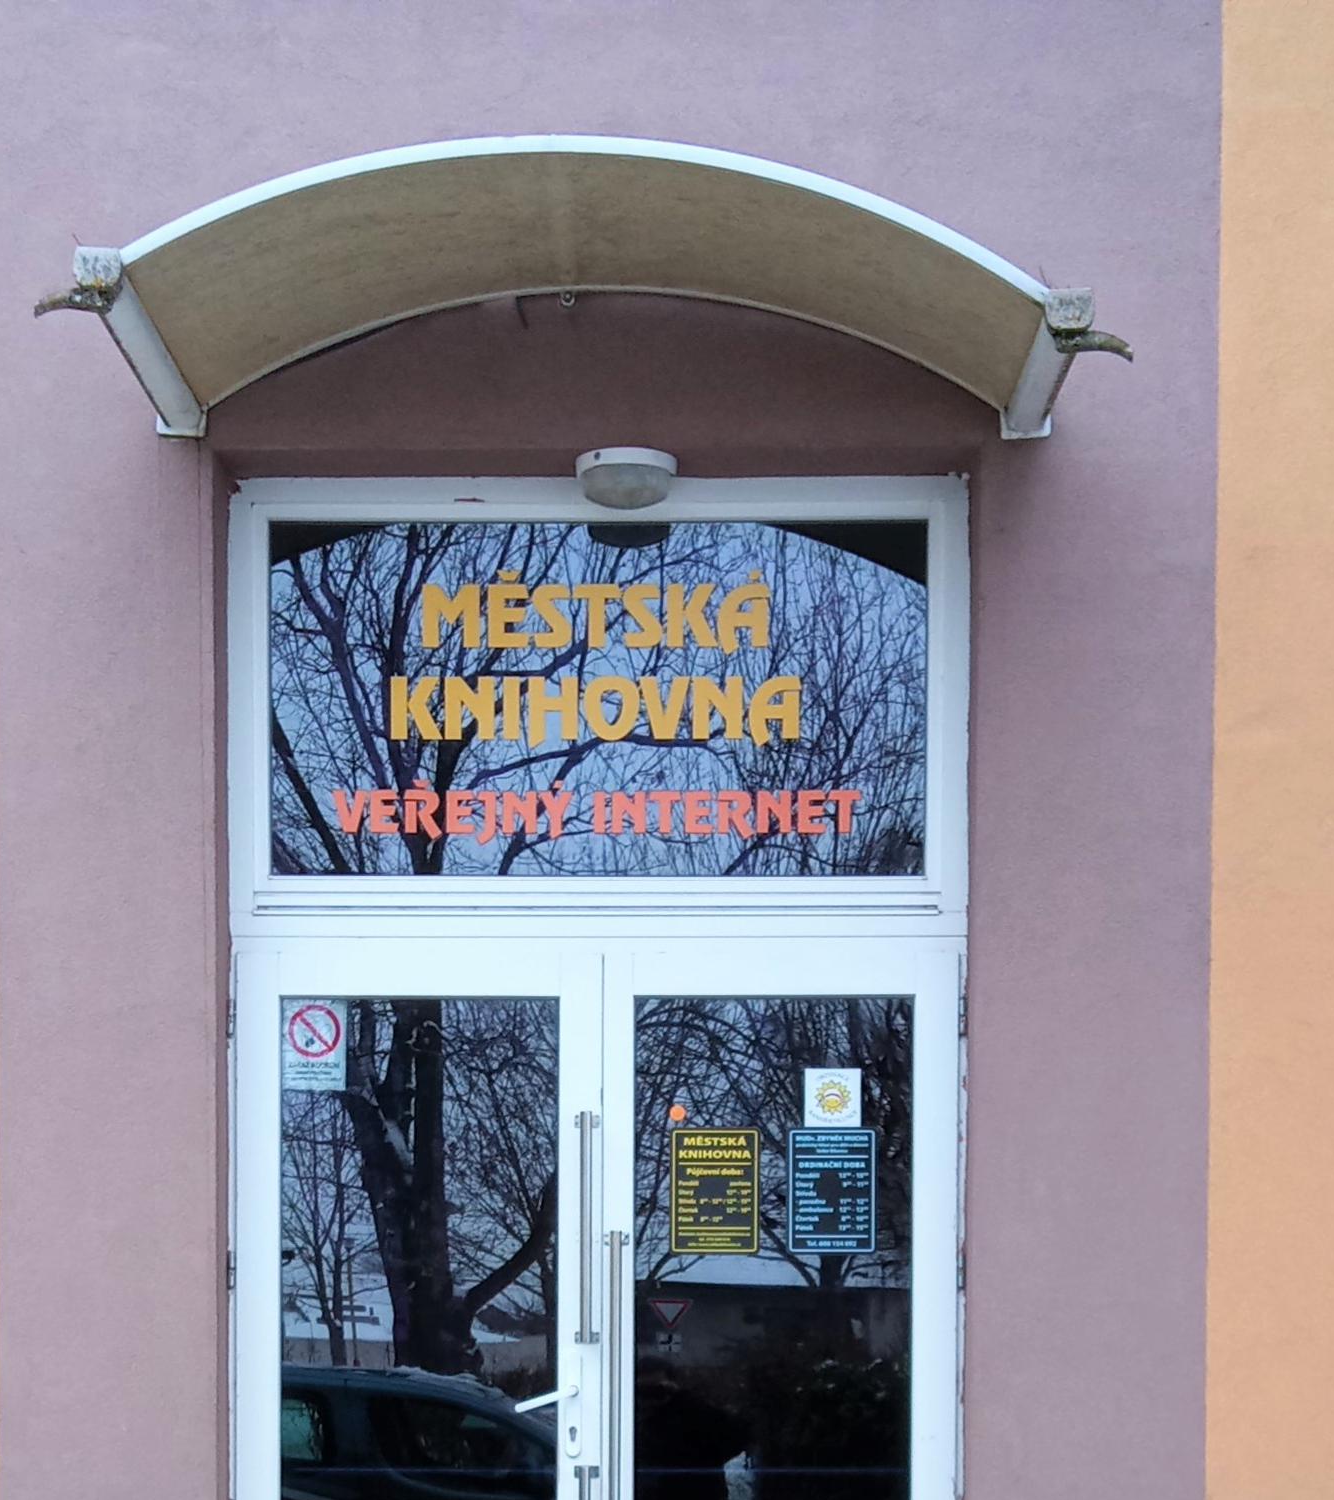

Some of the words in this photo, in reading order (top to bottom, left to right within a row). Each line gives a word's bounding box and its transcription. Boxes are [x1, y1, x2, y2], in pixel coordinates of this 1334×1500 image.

[422, 570, 770, 655] MĚSTSKÁ
[389, 675, 802, 748] KNIHOVNA
[332, 779, 573, 844] VEŘEJNÝ
[593, 789, 862, 844] INTERNET
[679, 1149, 752, 1159] KNIHOVNA
[683, 1135, 747, 1146] MĚSTSKÁ
